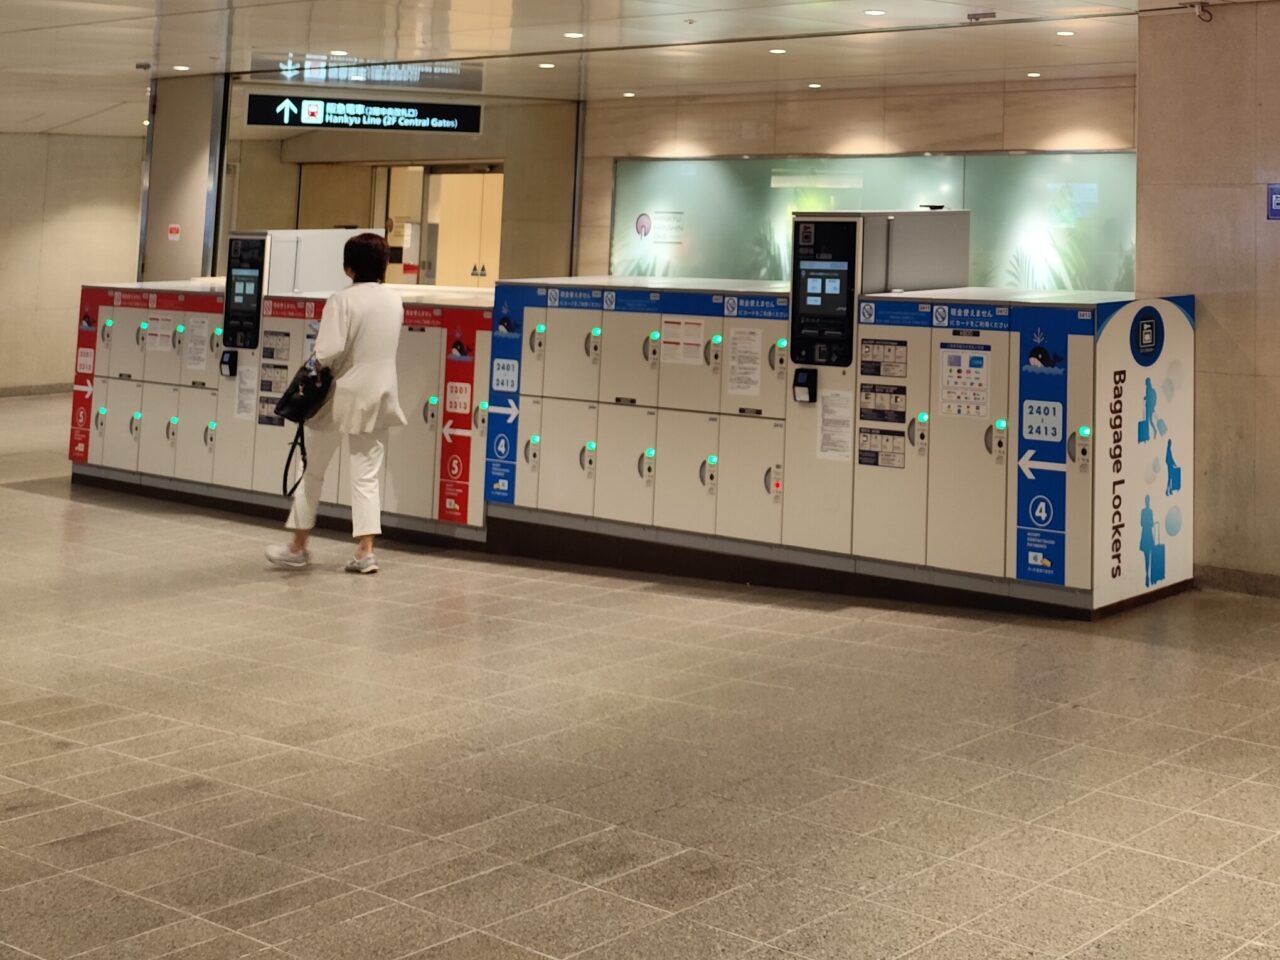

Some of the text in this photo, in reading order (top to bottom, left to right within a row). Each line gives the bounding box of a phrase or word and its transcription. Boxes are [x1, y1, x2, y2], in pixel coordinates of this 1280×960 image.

[326, 114, 361, 126] Hankyu
[362, 116, 381, 126] Line
[398, 117, 429, 127] Central
[431, 118, 458, 129] Gates)
[1027, 405, 1057, 416] 2401
[1027, 425, 1057, 437] 2413
[1109, 370, 1126, 579] Baggage Lockers
[1034, 501, 1048, 521] 4
